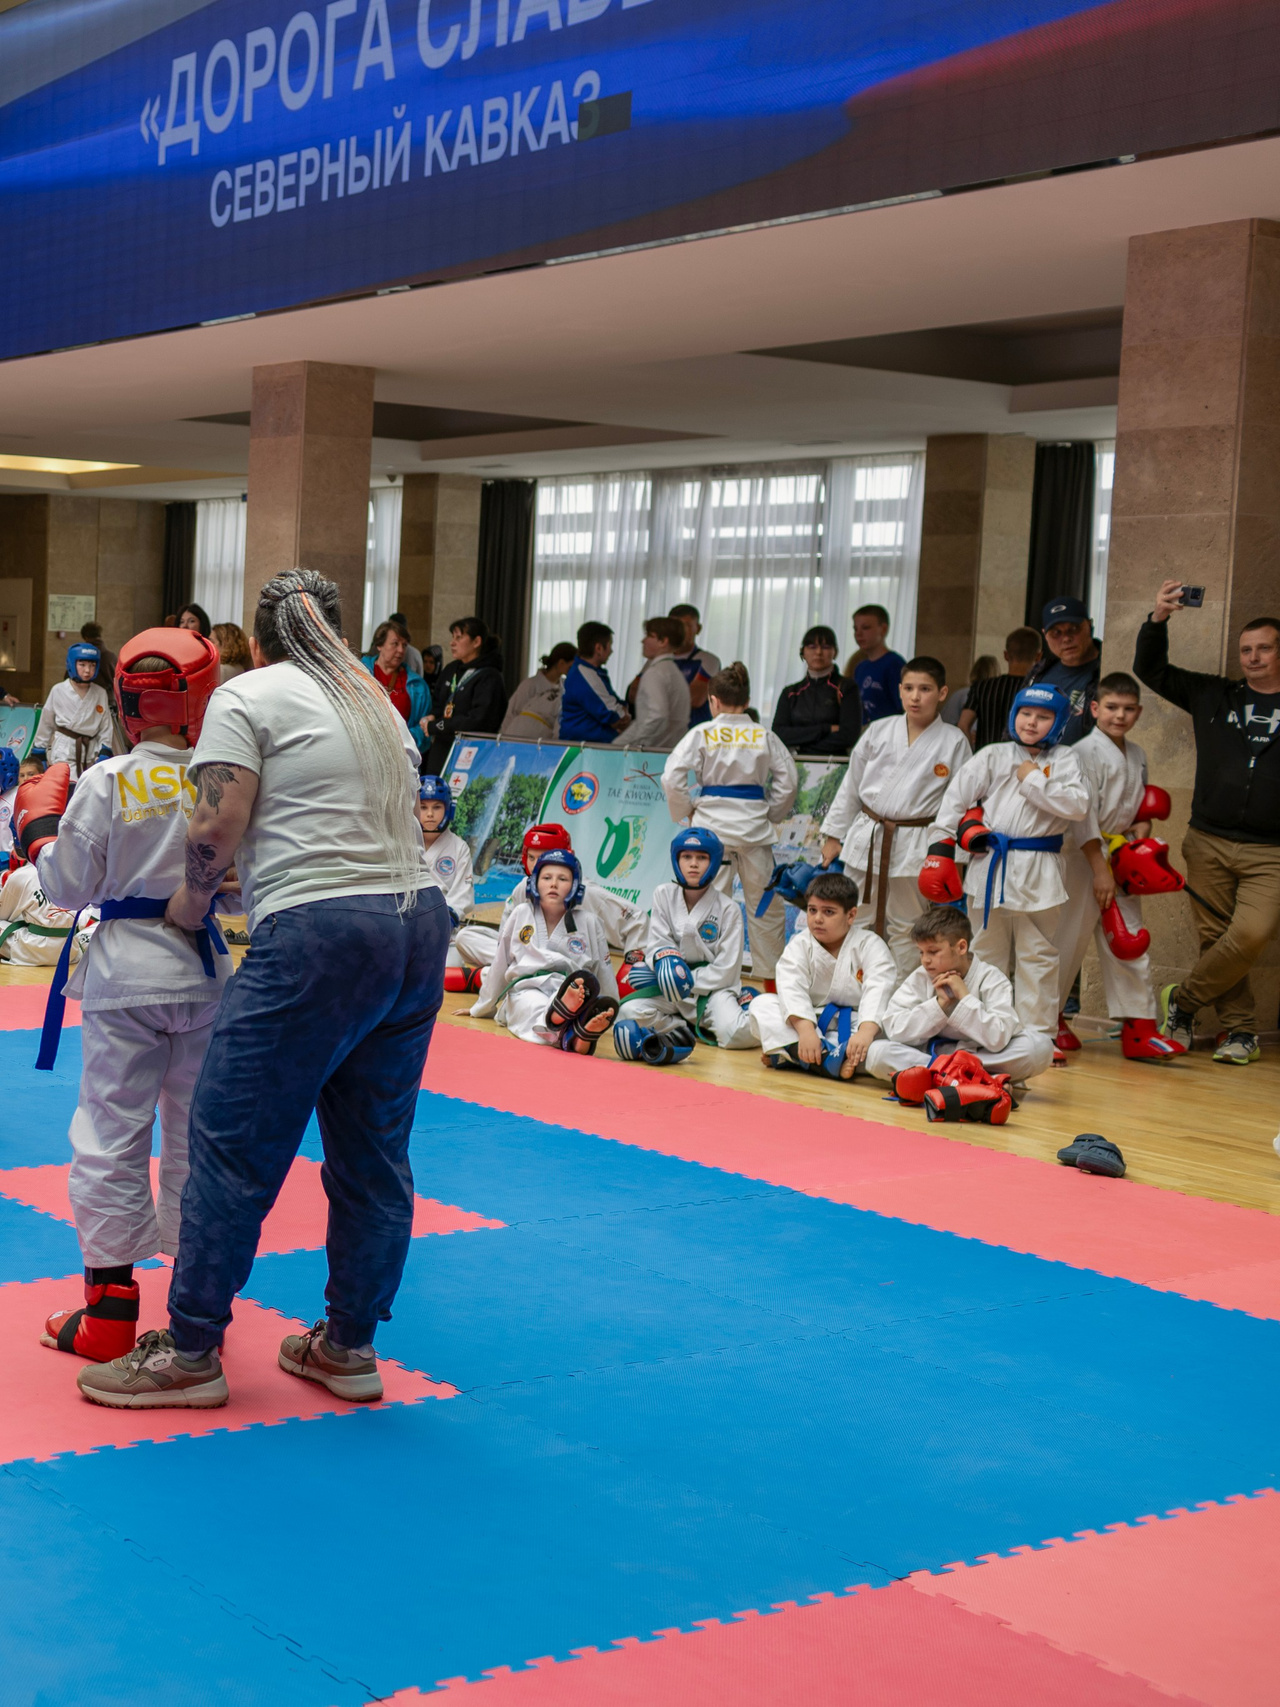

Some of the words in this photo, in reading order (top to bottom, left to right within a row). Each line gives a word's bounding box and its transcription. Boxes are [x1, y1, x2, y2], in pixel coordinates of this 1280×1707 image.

[139, 0, 396, 166] «ДОРОГА
[210, 103, 412, 228] СЕВЕРНЫЙ
[424, 70, 602, 178] КАВКАЗ
[703, 727, 766, 745] NSKF
[116, 765, 198, 809] NSK
[122, 801, 178, 823] Udmurt
